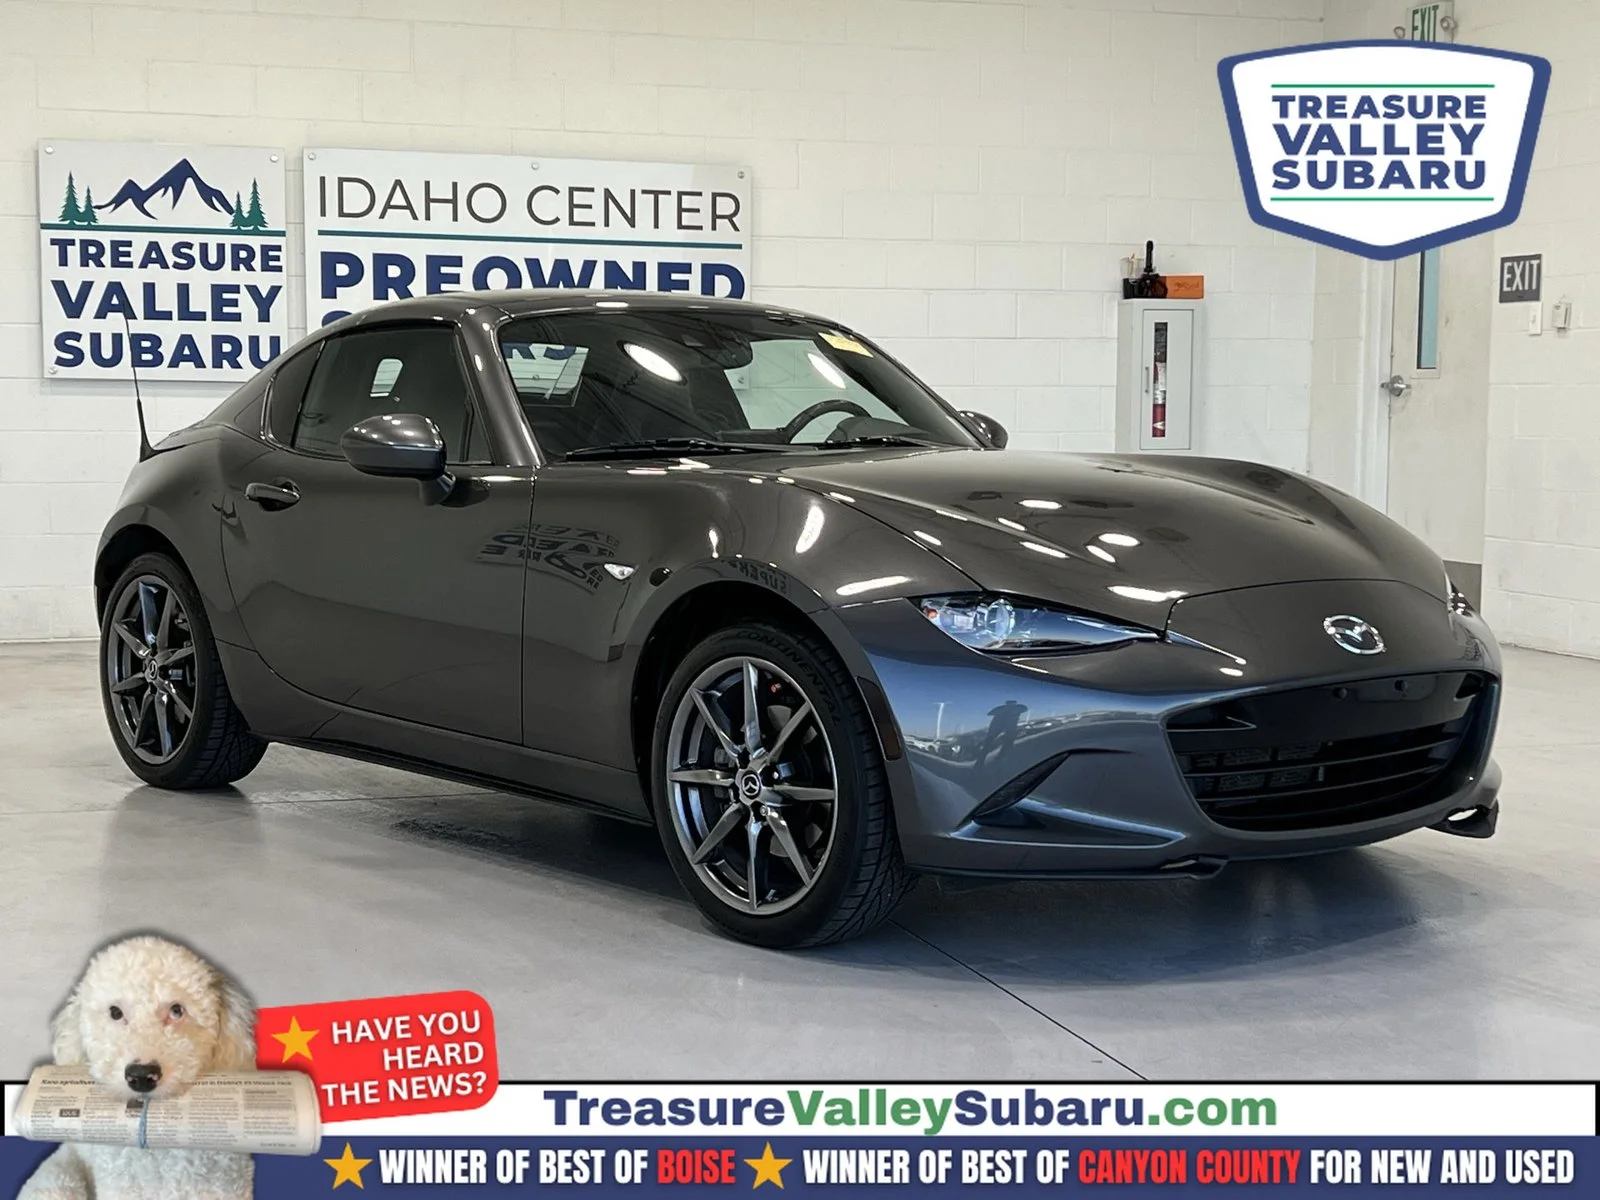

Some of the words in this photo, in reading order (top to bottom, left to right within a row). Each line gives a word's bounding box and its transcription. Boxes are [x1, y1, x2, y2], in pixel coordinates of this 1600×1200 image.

[1411, 4, 1440, 42] EXIT
[319, 176, 508, 224] IDAHO
[526, 184, 741, 232] CENTER
[50, 238, 284, 272] TREASURE
[320, 250, 746, 301] PREOWNED
[1502, 260, 1540, 292] EXIT
[50, 280, 283, 323] VALLEY
[54, 331, 281, 369] SUBARU
[736, 629, 842, 726] CONTINENTAL
